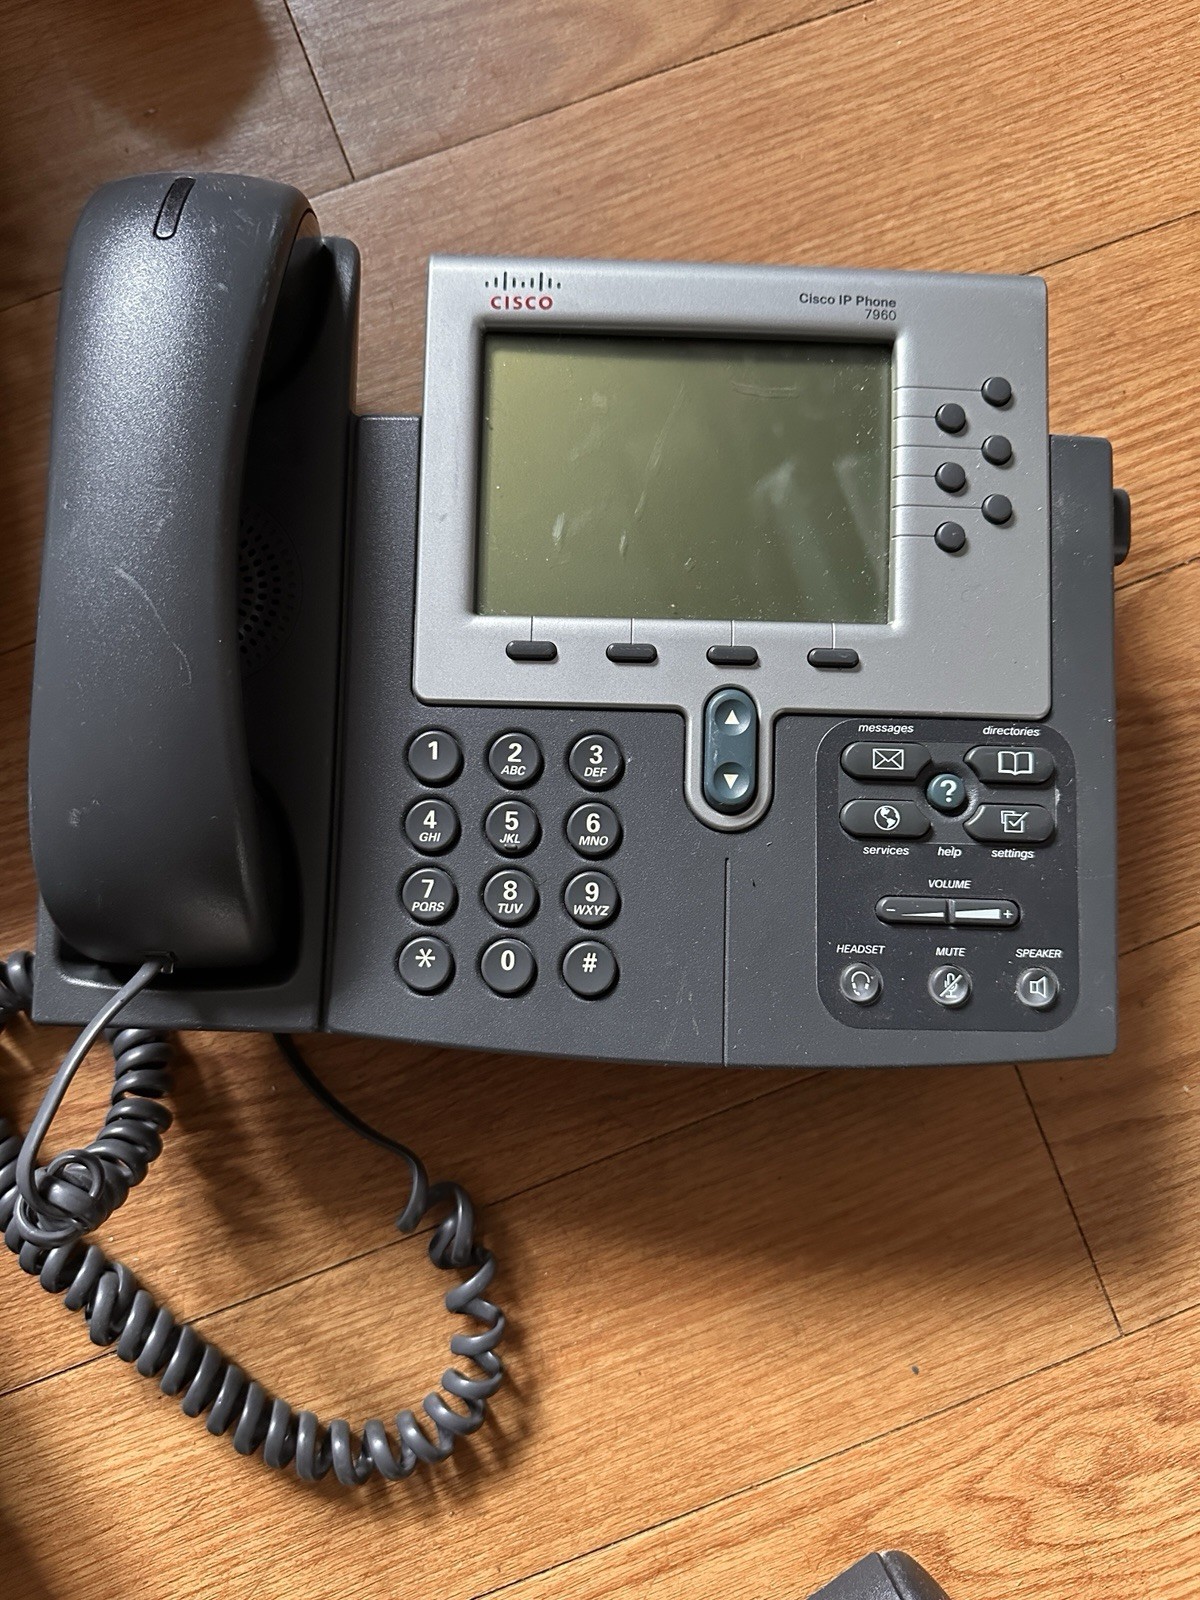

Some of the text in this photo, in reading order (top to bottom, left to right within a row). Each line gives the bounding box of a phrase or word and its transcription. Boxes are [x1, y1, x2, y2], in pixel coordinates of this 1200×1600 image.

[490, 296, 553, 310] CISCO
[799, 293, 897, 308] Cisco IP Phone
[865, 309, 897, 321] 7960
[858, 724, 914, 735] messages
[982, 725, 1041, 737] directories
[427, 741, 438, 760] 1
[507, 742, 522, 763] 2
[589, 744, 603, 765] 3
[500, 765, 527, 776] ABC
[583, 766, 608, 778] DEF
[940, 780, 957, 803] ?
[423, 810, 437, 829] 4
[504, 810, 519, 831] 5
[586, 813, 601, 834] 6
[418, 832, 442, 842] GHI
[499, 833, 521, 844] JKL
[578, 835, 609, 846] MNO
[862, 846, 910, 856] services
[937, 846, 962, 858] help
[990, 848, 1035, 860] settings
[421, 879, 435, 899] 7
[502, 880, 518, 901] 8
[928, 879, 972, 890] VOLUME
[584, 882, 600, 903] 9
[411, 901, 445, 913] PQRS
[497, 903, 524, 914] TUV
[573, 904, 610, 916] WXYZ
[836, 944, 886, 955] HEADSET
[935, 947, 966, 957] MUTE
[1015, 948, 1063, 959] SPEAKER
[500, 950, 515, 971] 0
[582, 952, 598, 973] #
